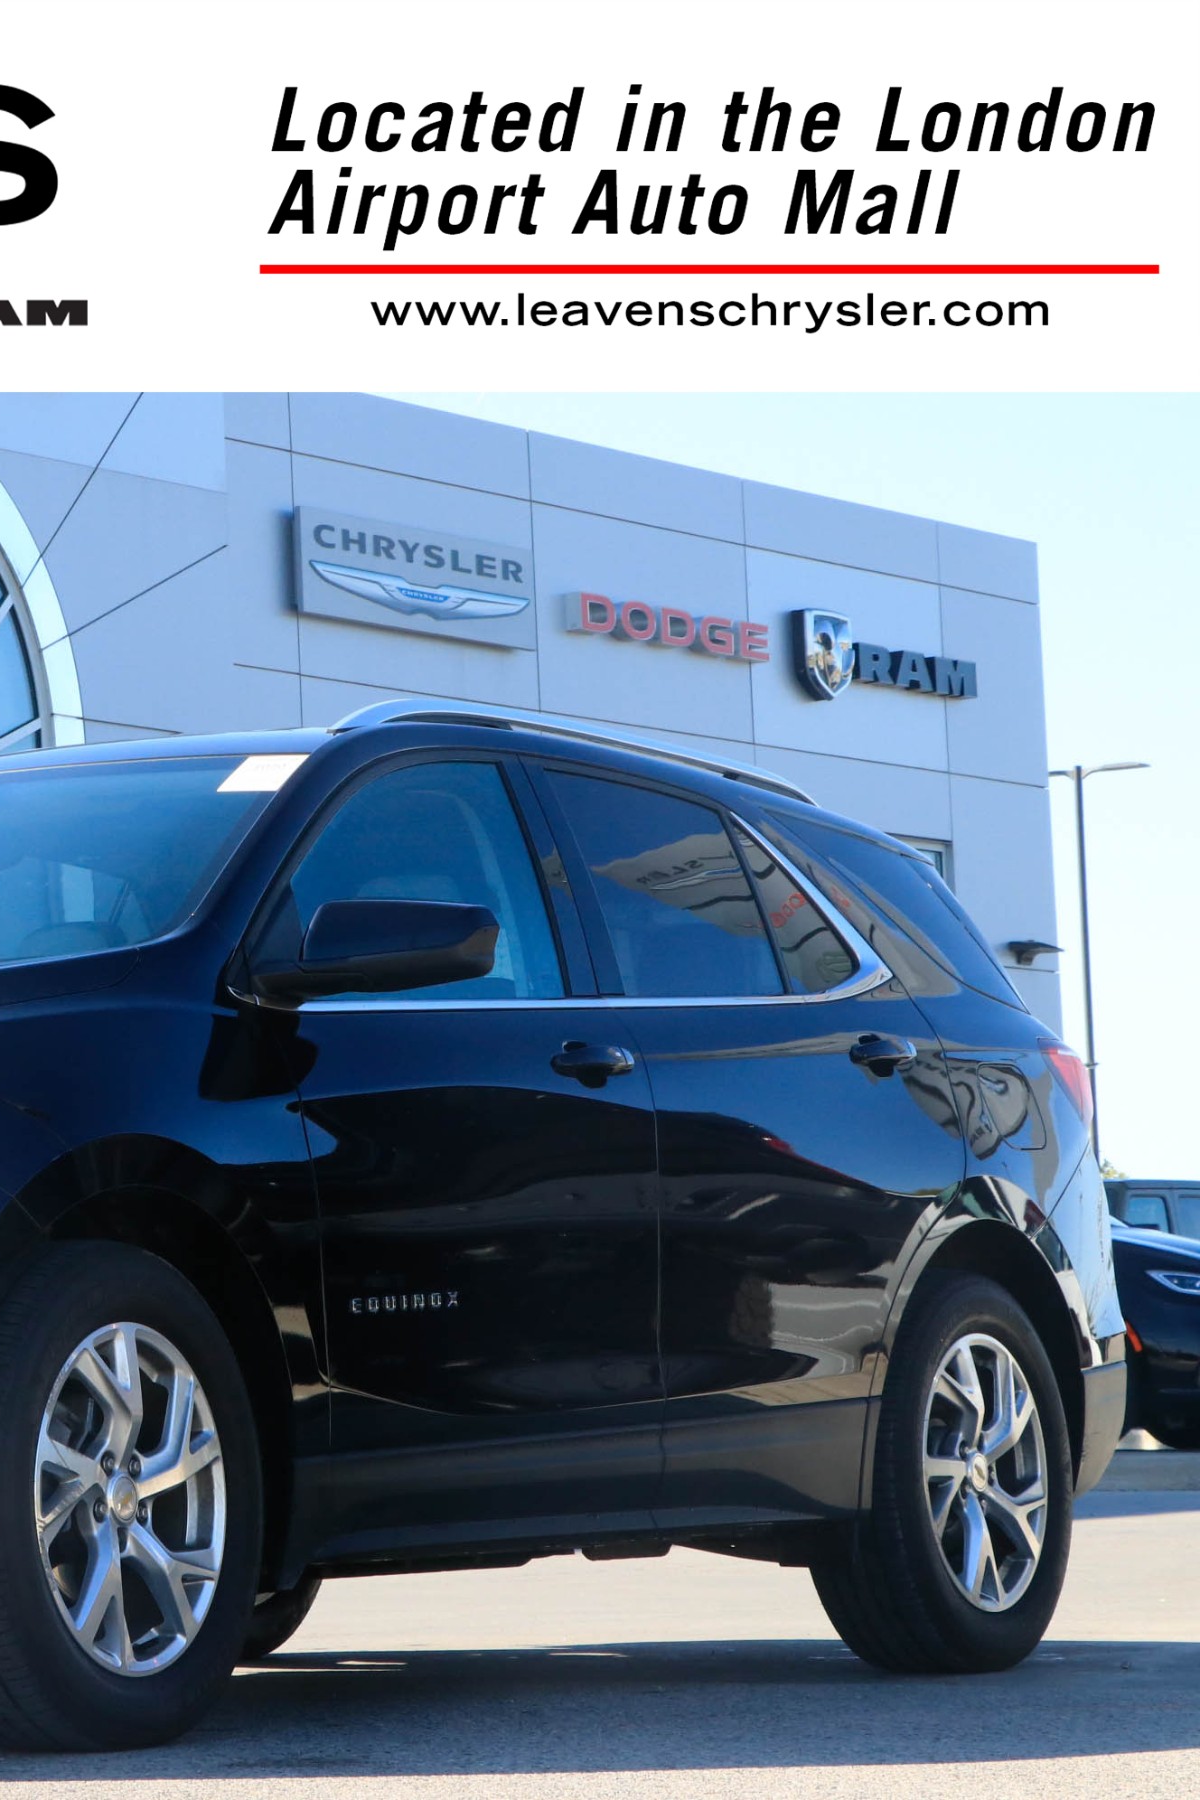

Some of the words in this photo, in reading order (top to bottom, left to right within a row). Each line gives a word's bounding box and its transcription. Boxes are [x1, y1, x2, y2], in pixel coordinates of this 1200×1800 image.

[313, 524, 523, 583] CHRYSLER
[579, 592, 769, 661] DODGE
[857, 642, 977, 698] RAM
[351, 1291, 458, 1313] EQUINOX
